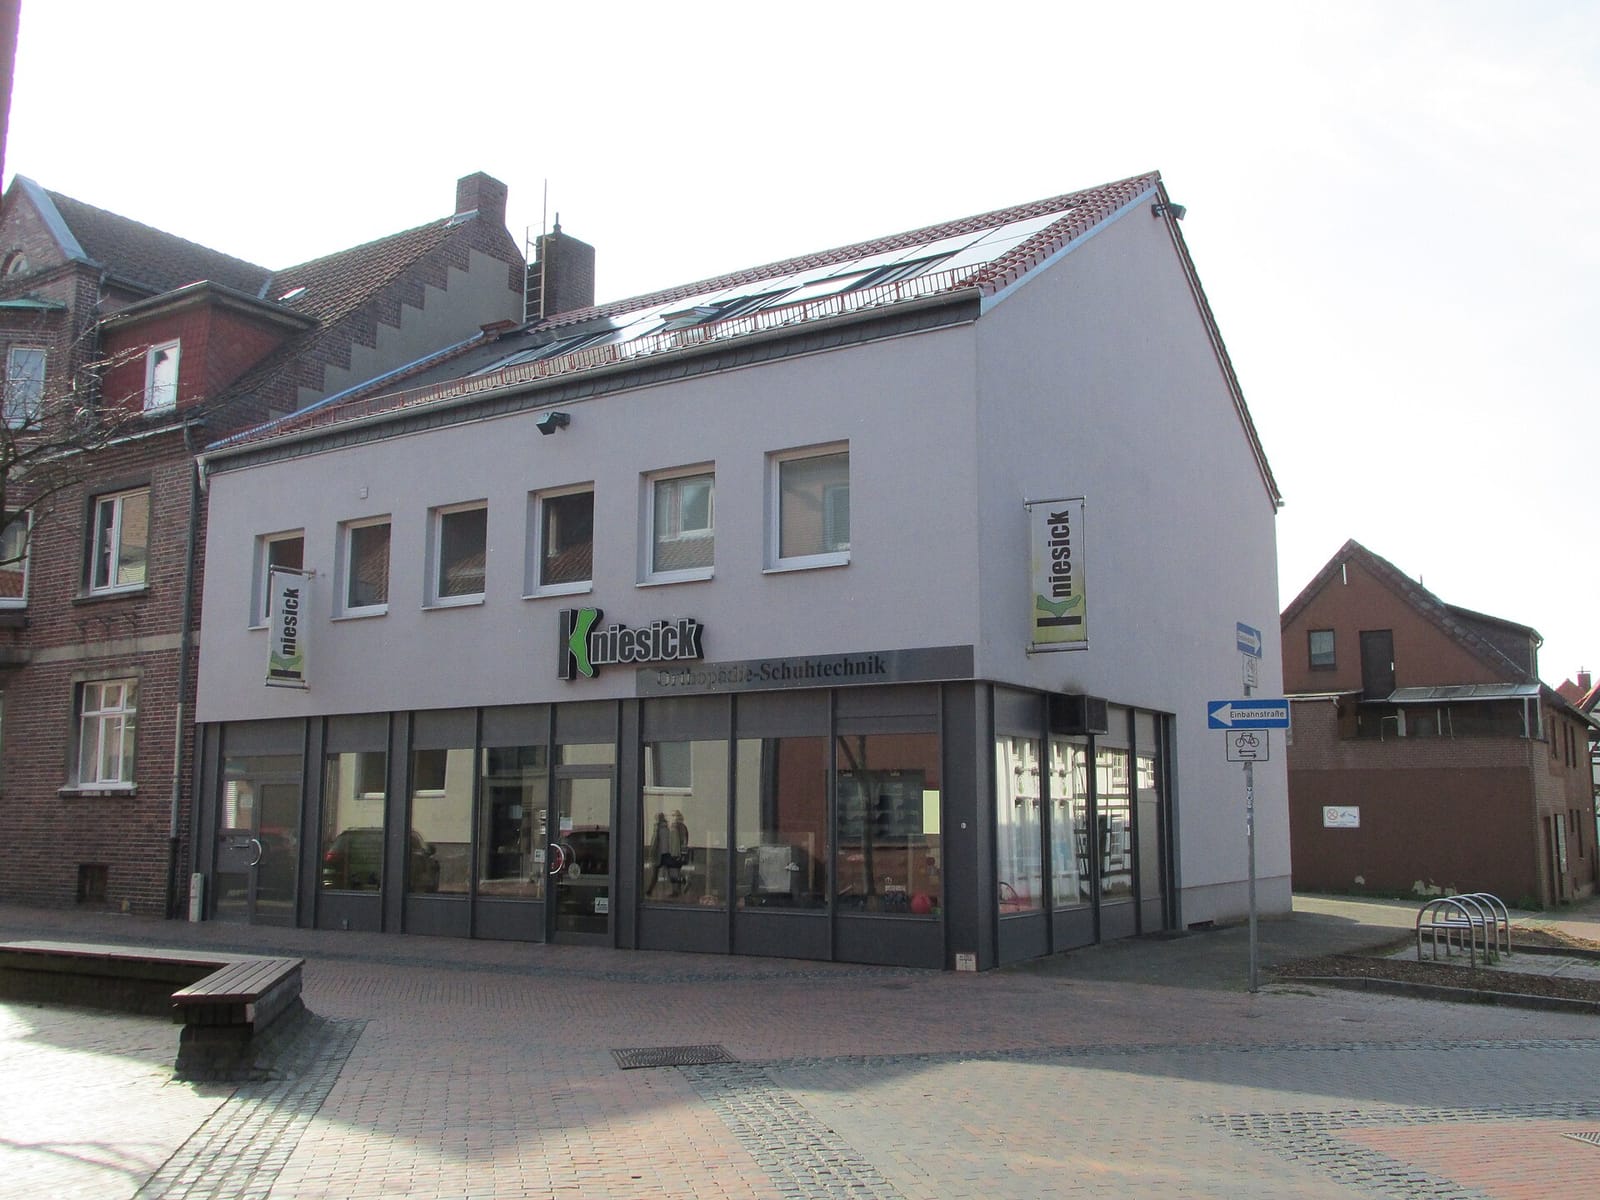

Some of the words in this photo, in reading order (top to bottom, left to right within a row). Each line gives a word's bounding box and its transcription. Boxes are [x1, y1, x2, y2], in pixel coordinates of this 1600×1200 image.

[1036, 509, 1083, 628] Kniesick
[270, 587, 300, 679] Kniesick
[557, 607, 704, 680] Kniesick
[1230, 710, 1285, 719] Einbahnstraße
